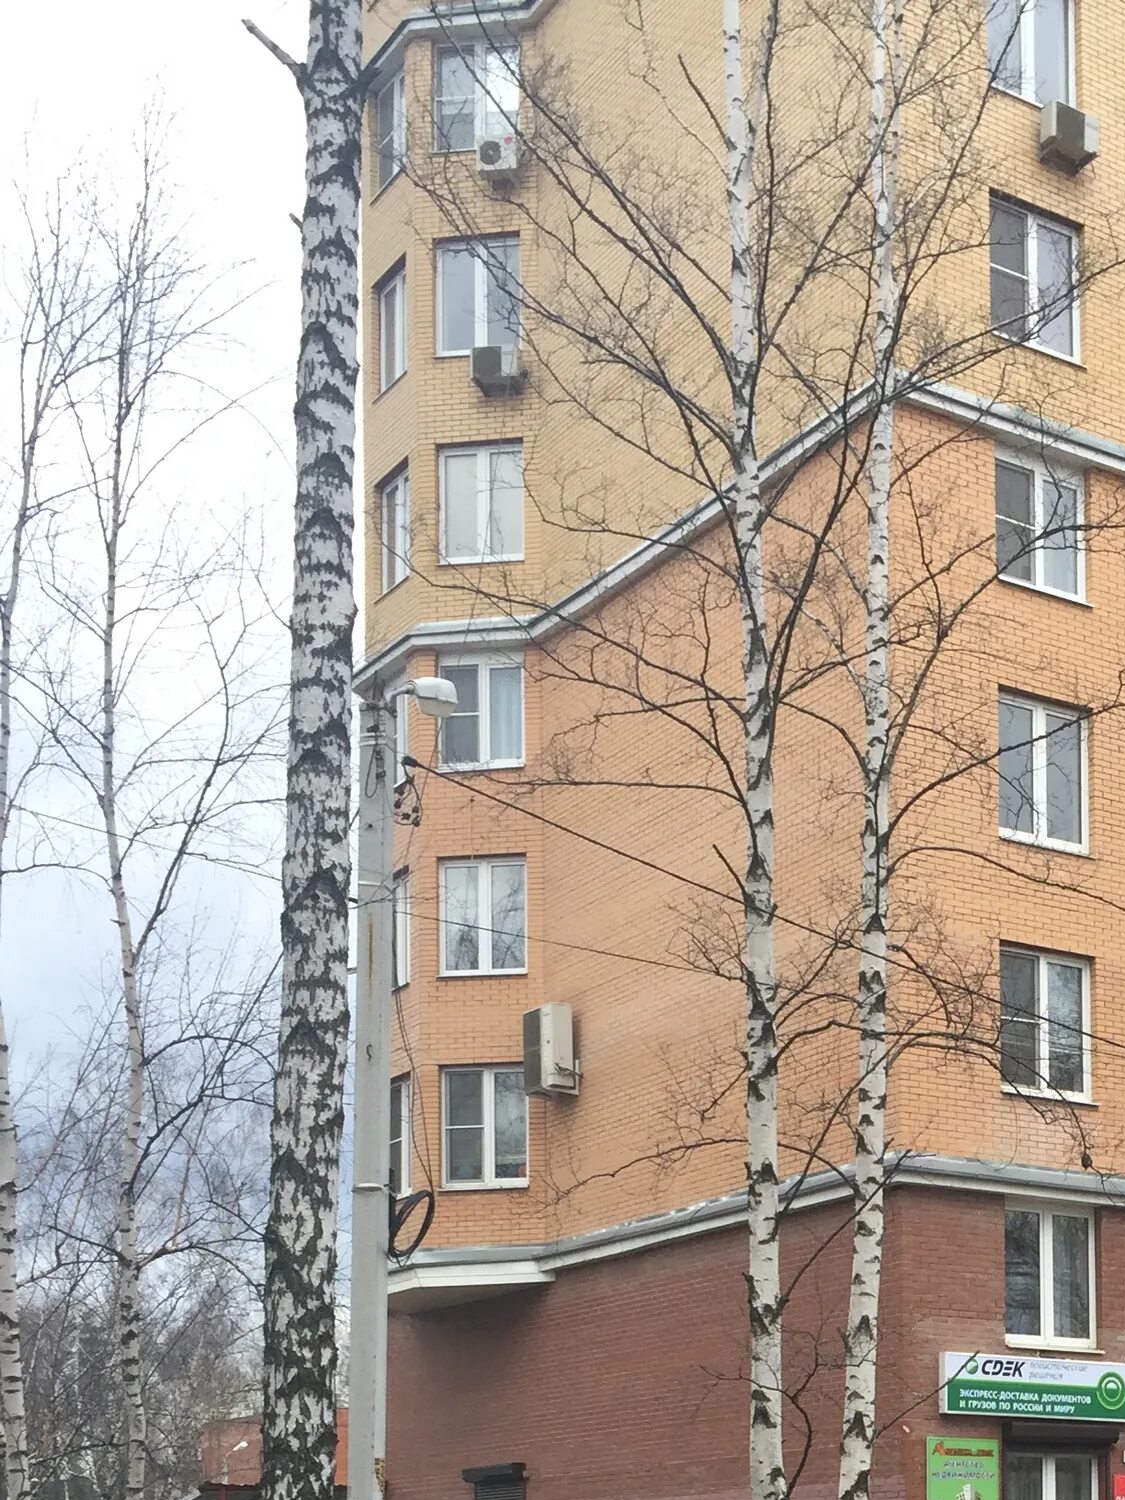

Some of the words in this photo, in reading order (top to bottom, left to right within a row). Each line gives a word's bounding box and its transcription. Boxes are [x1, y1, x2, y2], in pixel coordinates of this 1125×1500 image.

[981, 1359, 1026, 1378] CDEK
[959, 1388, 1039, 1402] ЭКСПРЕСС-ДОСТАВКА
[1041, 1393, 1092, 1404] ДОКУМЕНТОВ
[959, 1399, 965, 1407] И
[967, 1400, 997, 1409] ГРУЗОВ
[999, 1402, 1011, 1410] ПО
[1013, 1402, 1044, 1412] РОССИИ
[1054, 1405, 1076, 1414] МИРУ
